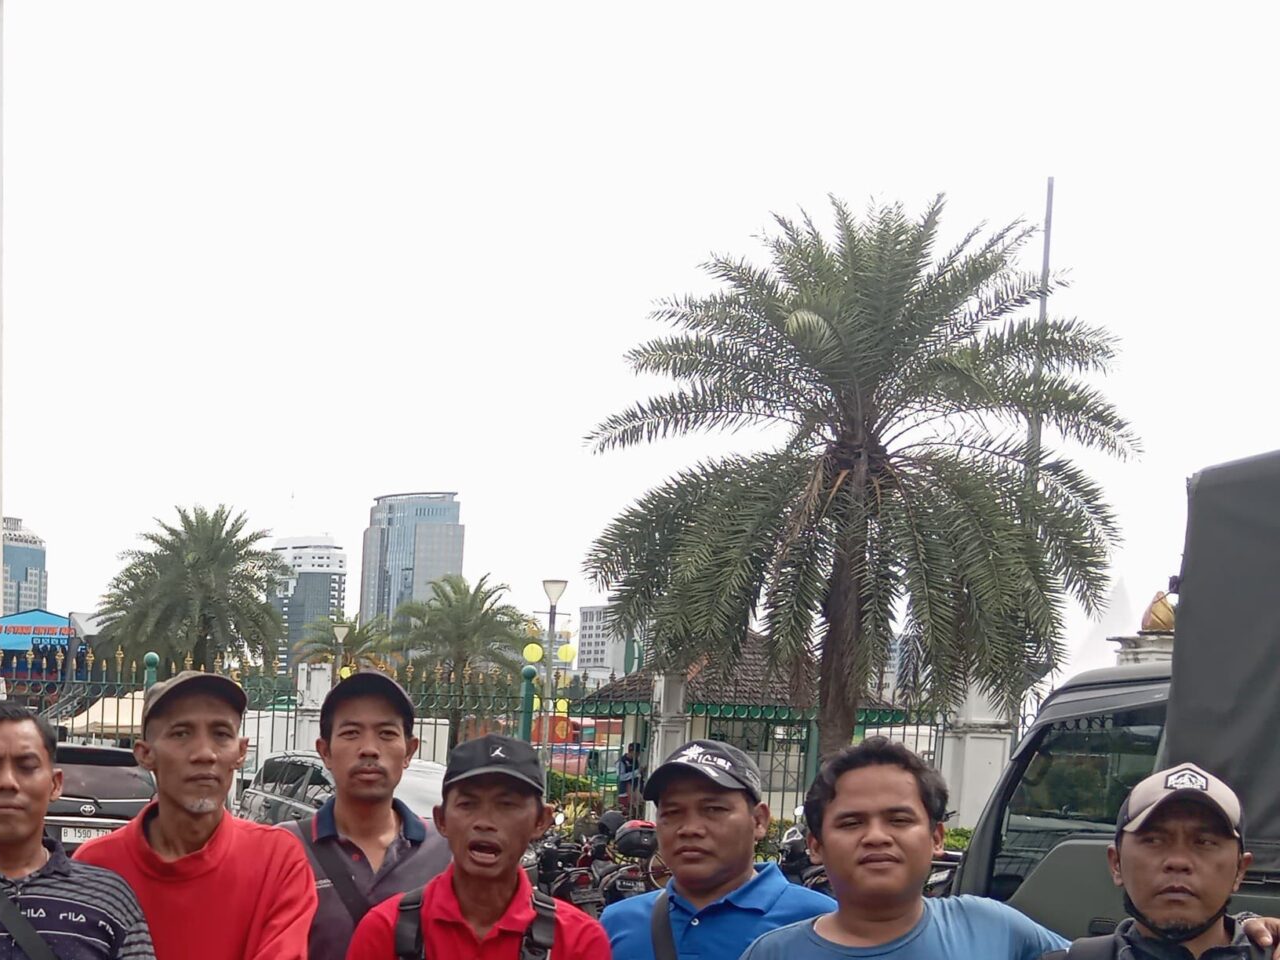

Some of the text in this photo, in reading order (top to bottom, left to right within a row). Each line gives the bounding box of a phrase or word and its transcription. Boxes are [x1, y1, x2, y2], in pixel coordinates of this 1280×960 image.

[63, 828, 68, 837] B
[74, 829, 92, 839] 1590
[59, 912, 86, 923] FILA
